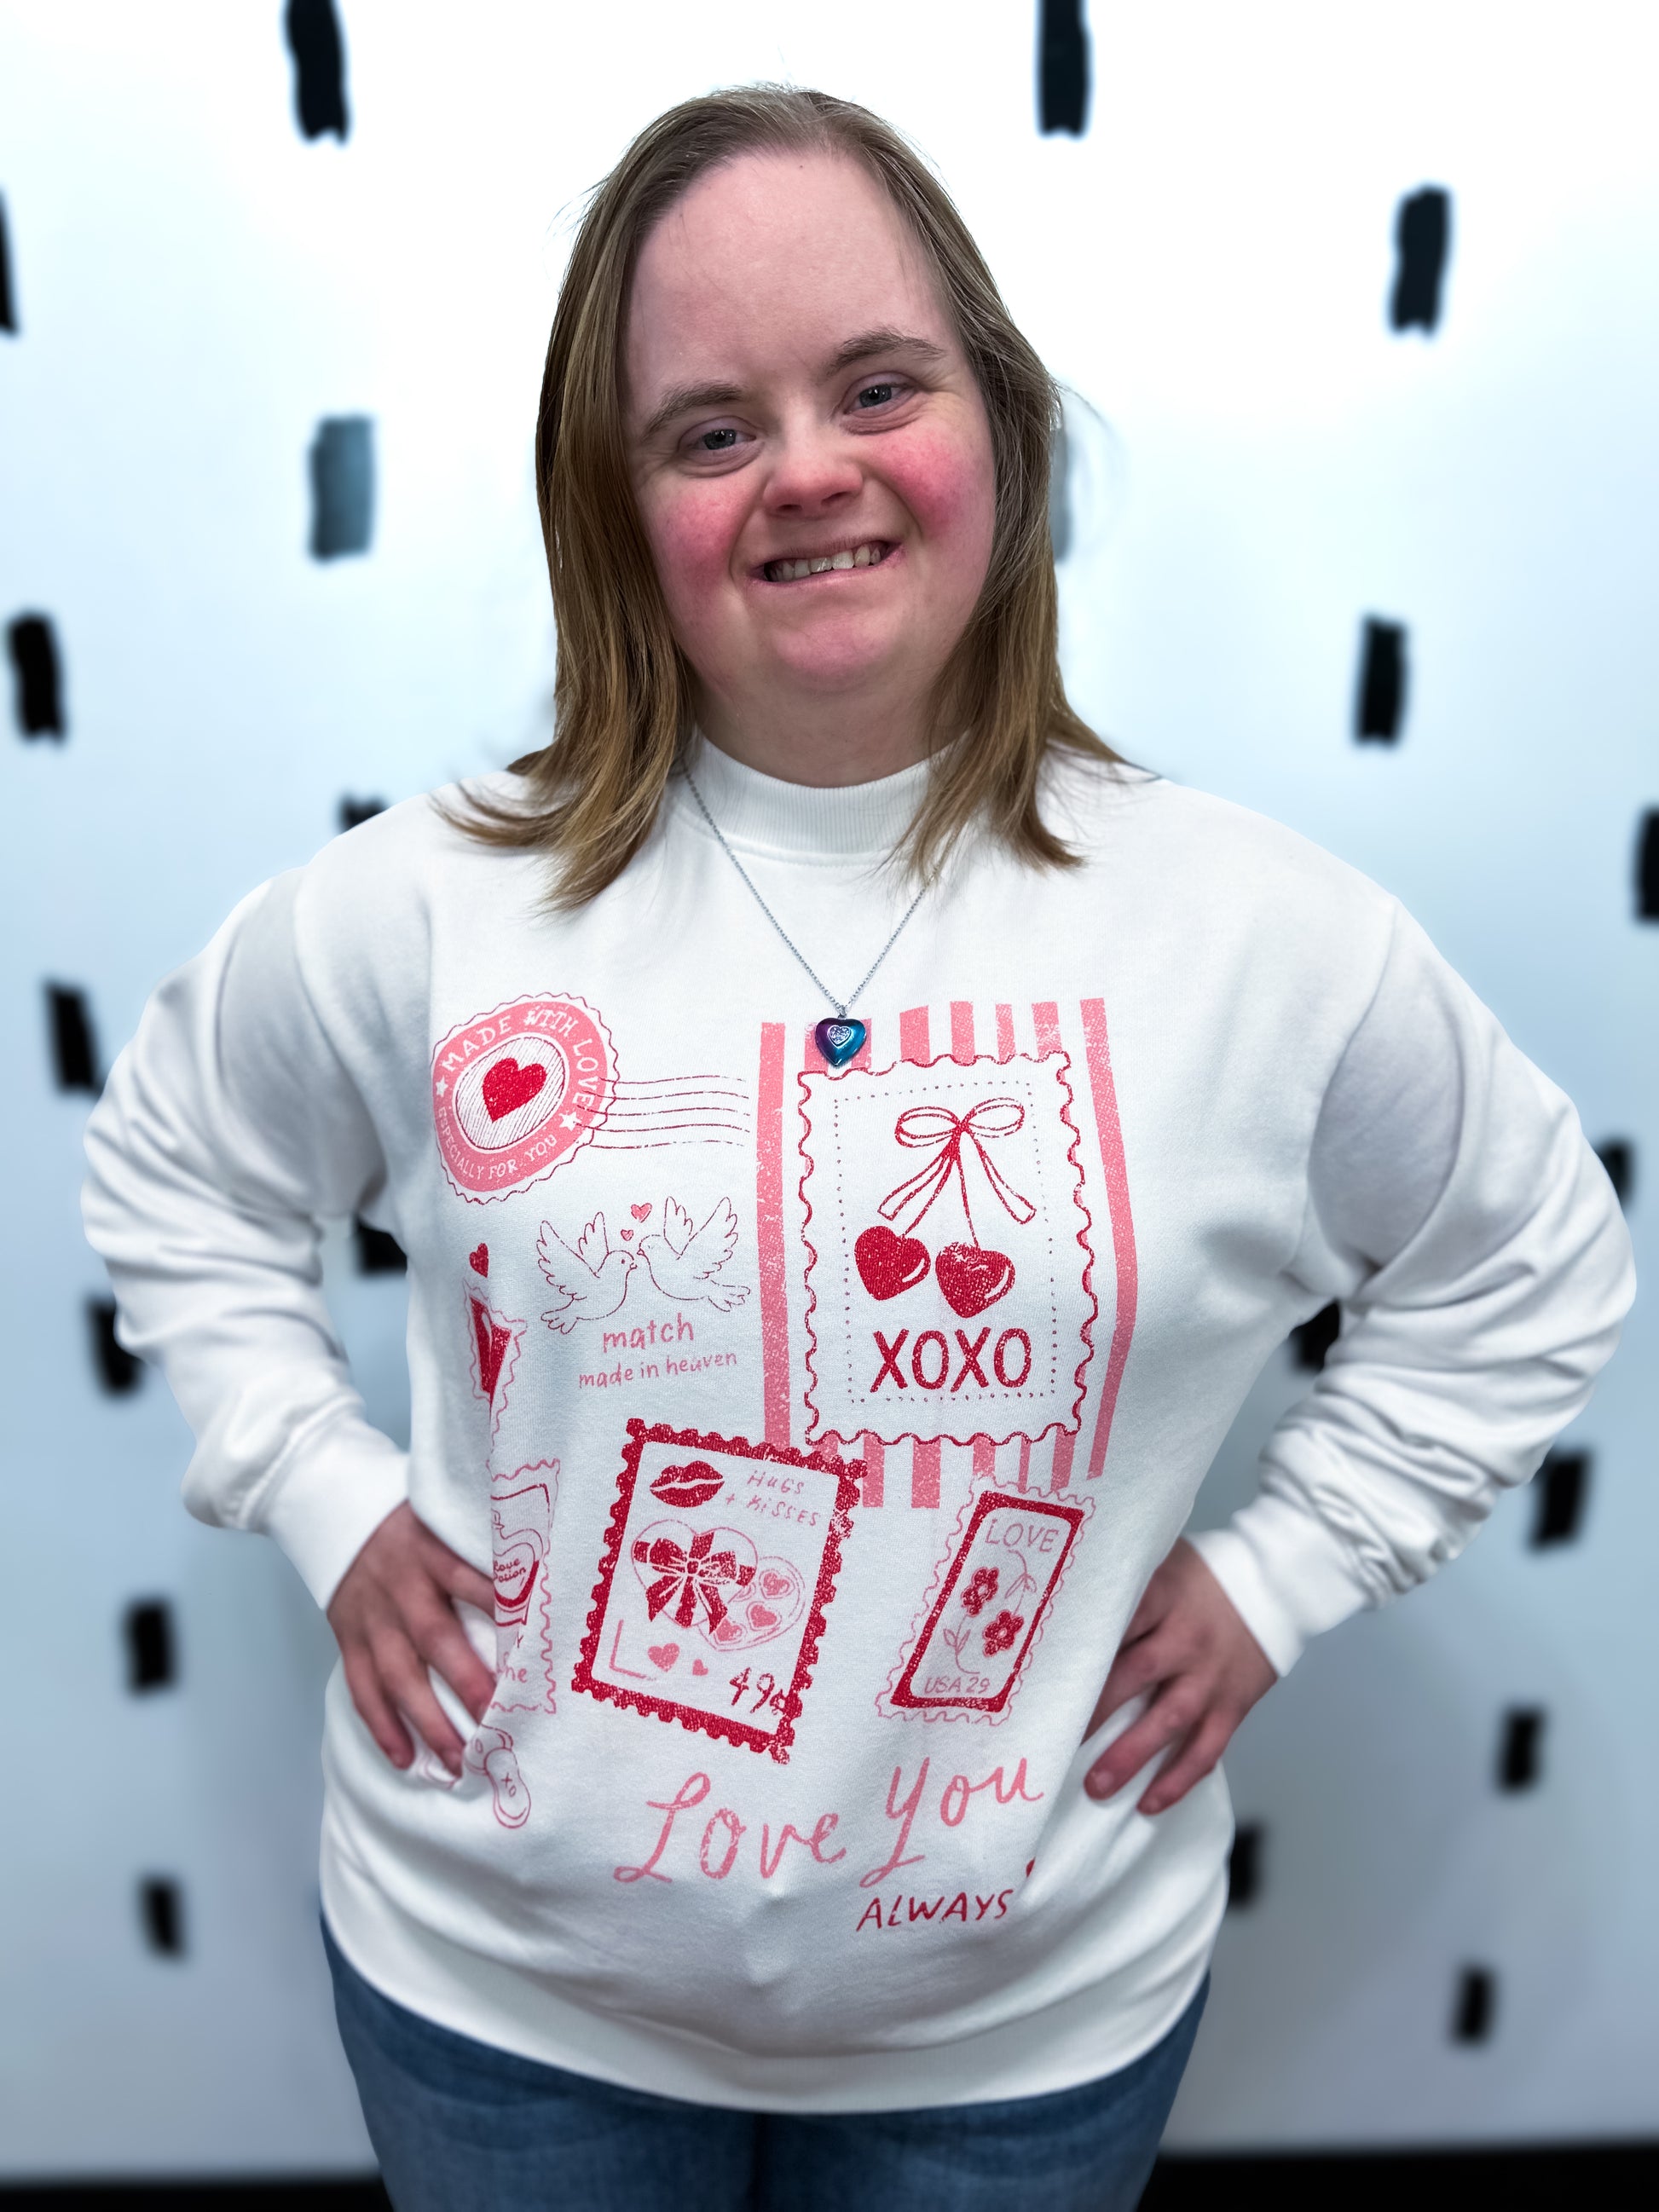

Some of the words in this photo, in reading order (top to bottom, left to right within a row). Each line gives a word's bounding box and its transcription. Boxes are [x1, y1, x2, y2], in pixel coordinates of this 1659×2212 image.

[442, 1015, 512, 1071] MADE
[523, 1009, 580, 1037] WITH
[572, 1038, 600, 1108] LOVE
[437, 1108, 484, 1180] ESPECIALLY
[488, 1159, 518, 1180] FOR
[524, 1134, 558, 1162] YOU
[603, 1313, 694, 1353] match
[579, 1362, 633, 1389] made
[640, 1362, 659, 1378] in
[667, 1353, 737, 1375] heaven
[870, 1327, 1032, 1393] XOXO
[985, 1518, 1060, 1553] LOVE
[924, 1676, 961, 1694] USA
[856, 1889, 1014, 1932] ALWAYS
